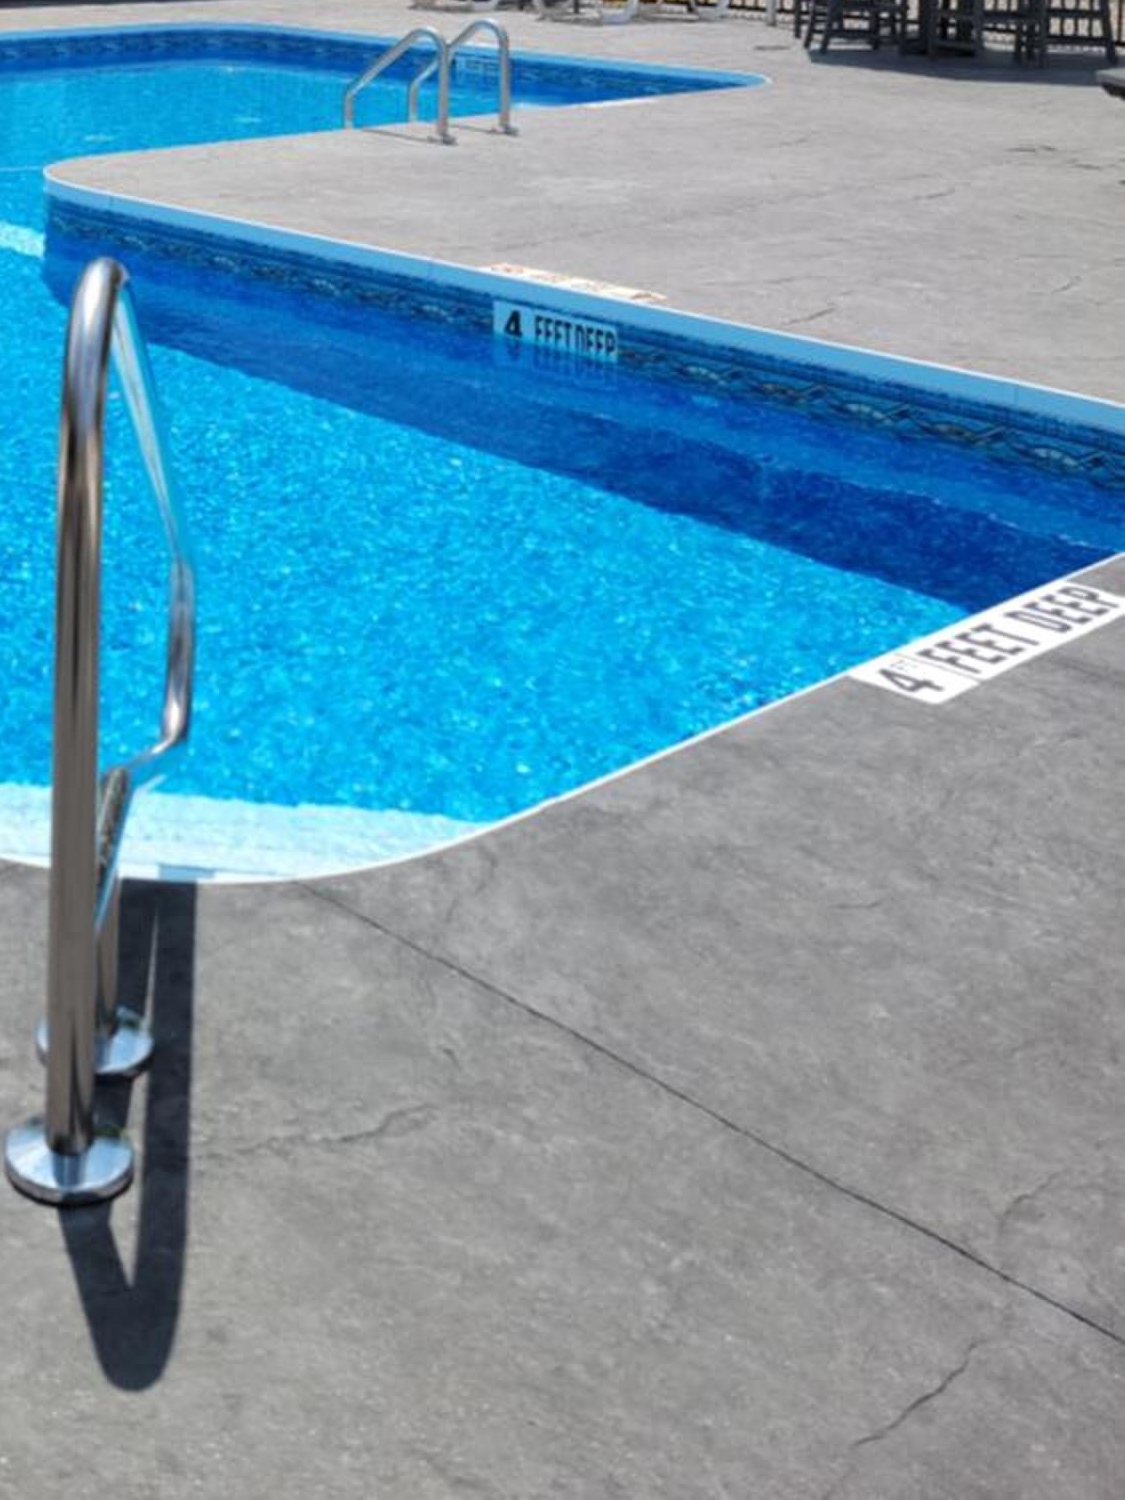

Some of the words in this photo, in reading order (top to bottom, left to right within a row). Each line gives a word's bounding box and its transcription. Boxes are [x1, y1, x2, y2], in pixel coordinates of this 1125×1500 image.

[504, 310, 523, 338] 4
[534, 315, 572, 346] FEET
[577, 325, 616, 355] DEEP
[878, 667, 944, 693] 4
[916, 622, 1041, 675] FEET
[1002, 585, 1121, 634] DEEP
